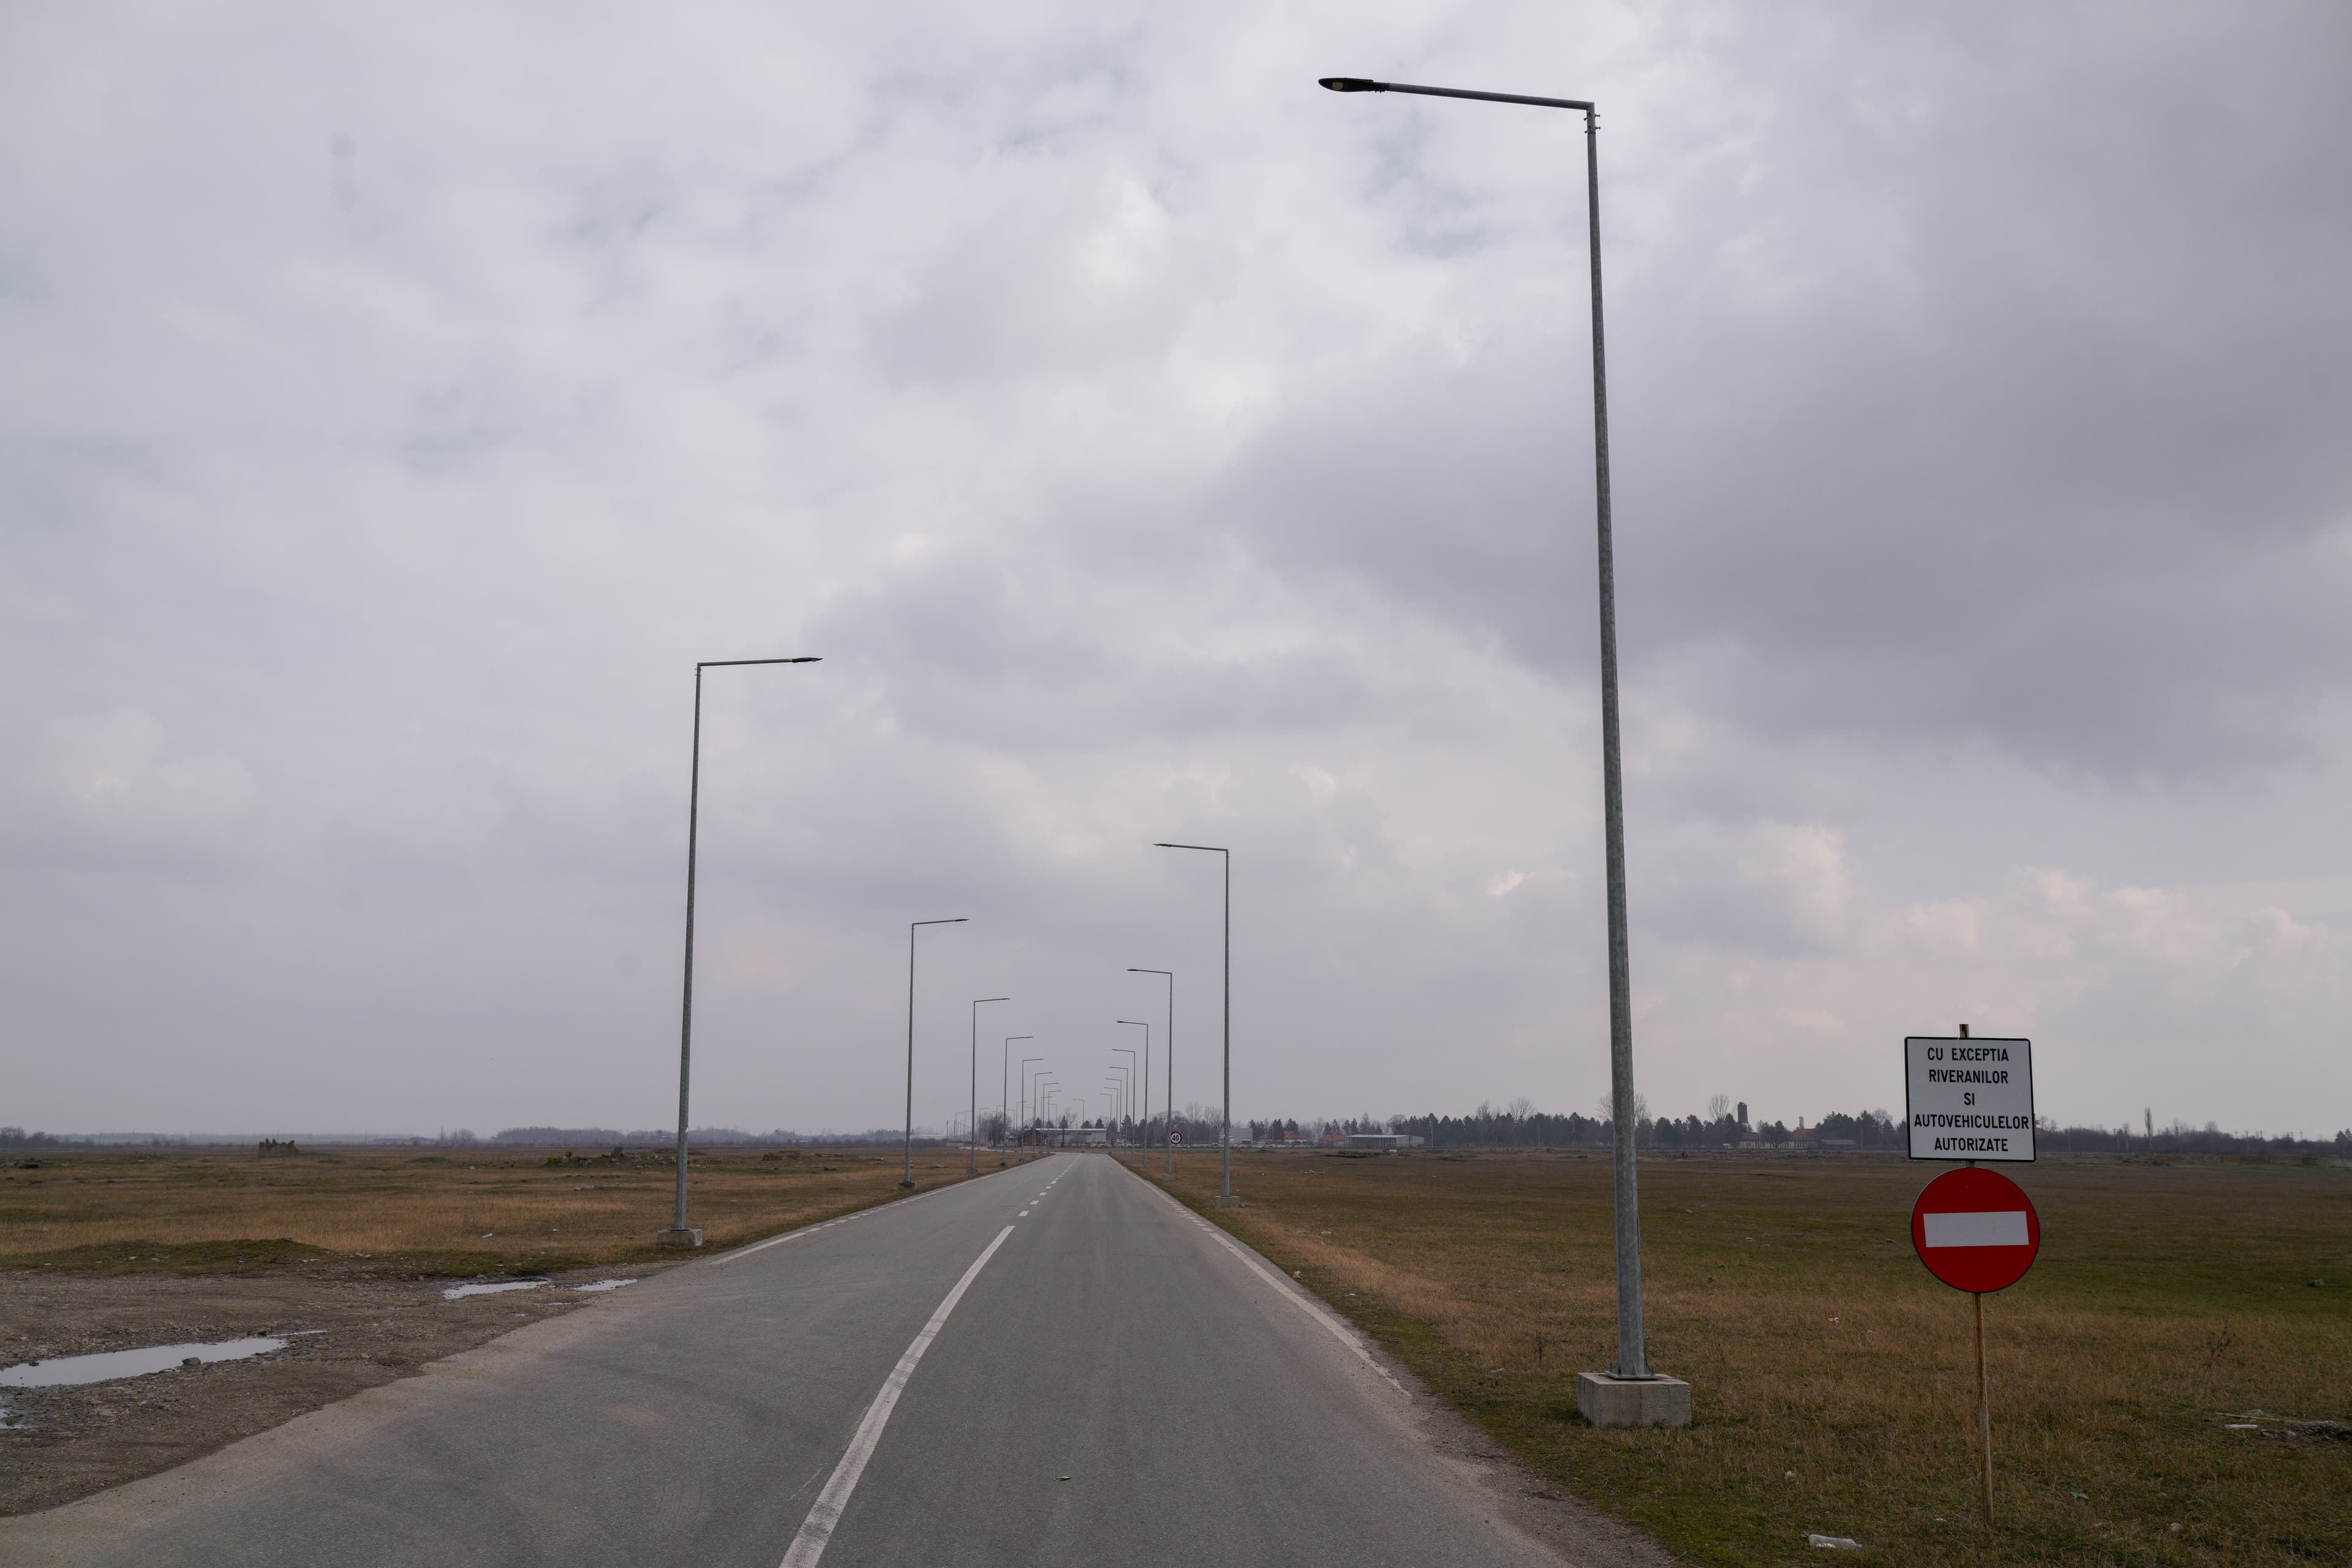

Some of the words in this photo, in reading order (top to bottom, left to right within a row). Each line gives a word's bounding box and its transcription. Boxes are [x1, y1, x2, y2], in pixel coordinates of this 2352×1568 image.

[1928, 1047, 1943, 1060] CU
[1951, 1048, 2009, 1061] EXCEPTIA
[1929, 1069, 2008, 1084] RIVERANILOR
[1964, 1092, 1975, 1106] SI
[1914, 1114, 2029, 1129] AUTOVEHICULELOR
[1934, 1137, 2008, 1152] AUTORIZATE
